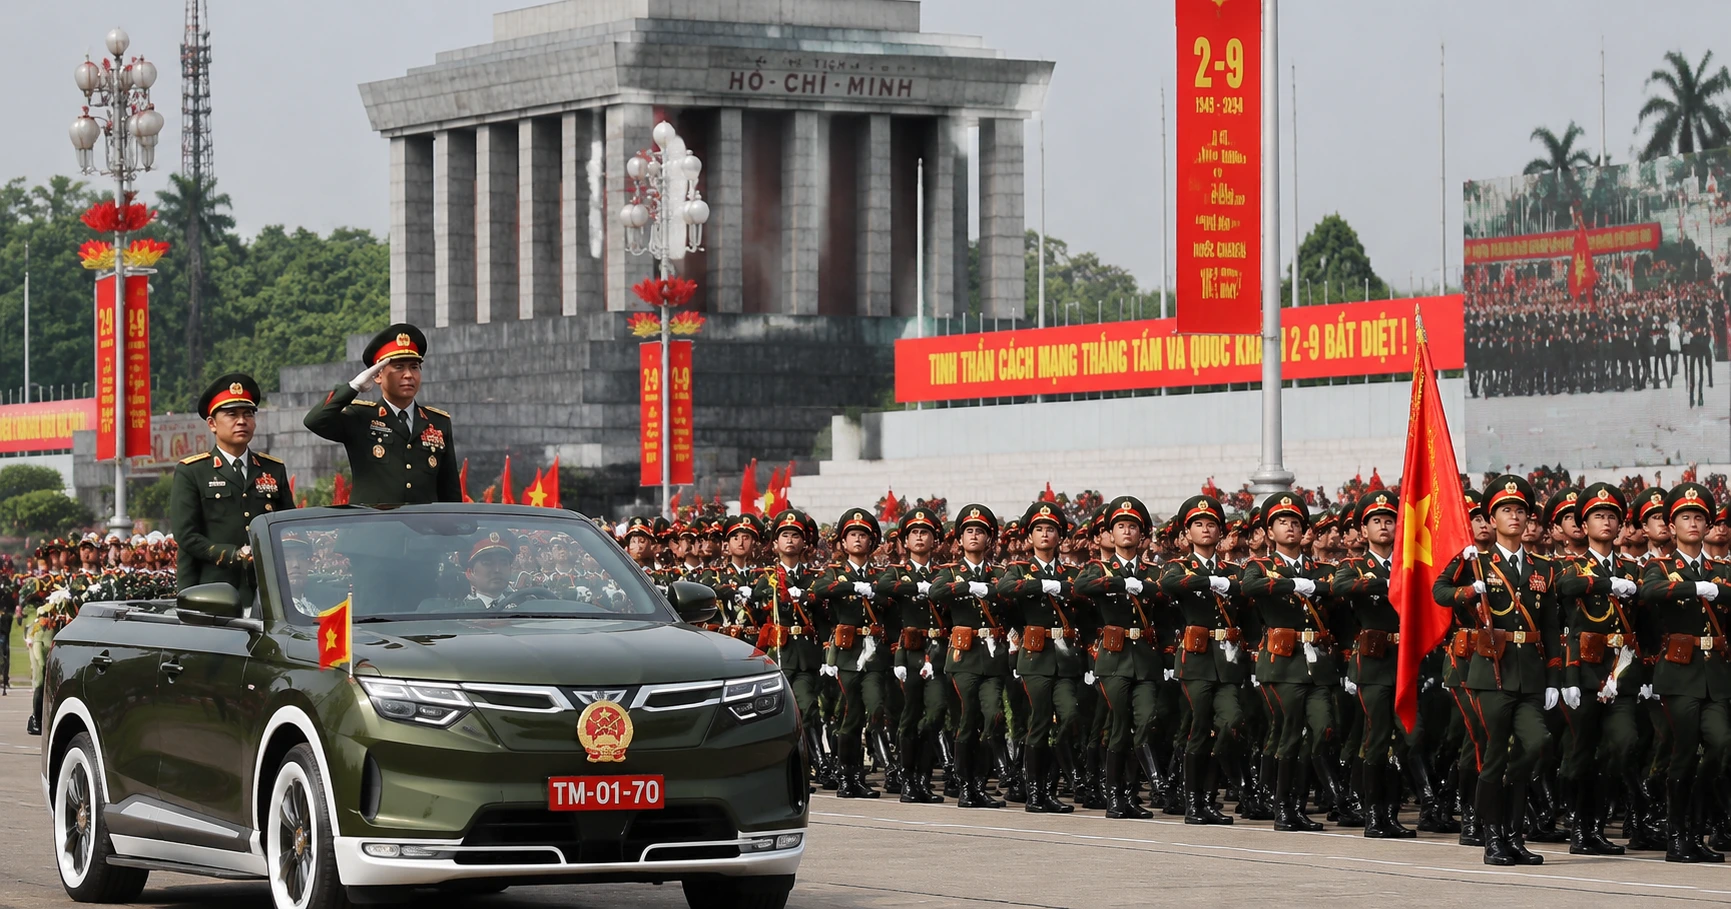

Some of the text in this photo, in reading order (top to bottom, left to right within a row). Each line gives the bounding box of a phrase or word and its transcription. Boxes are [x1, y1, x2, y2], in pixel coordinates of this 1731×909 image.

[1194, 36, 1244, 88] 2-9
[847, 75, 913, 98] MINH
[929, 351, 957, 385] TINH
[1038, 343, 1078, 385] MẠNG
[553, 779, 660, 806] TM-01-70
